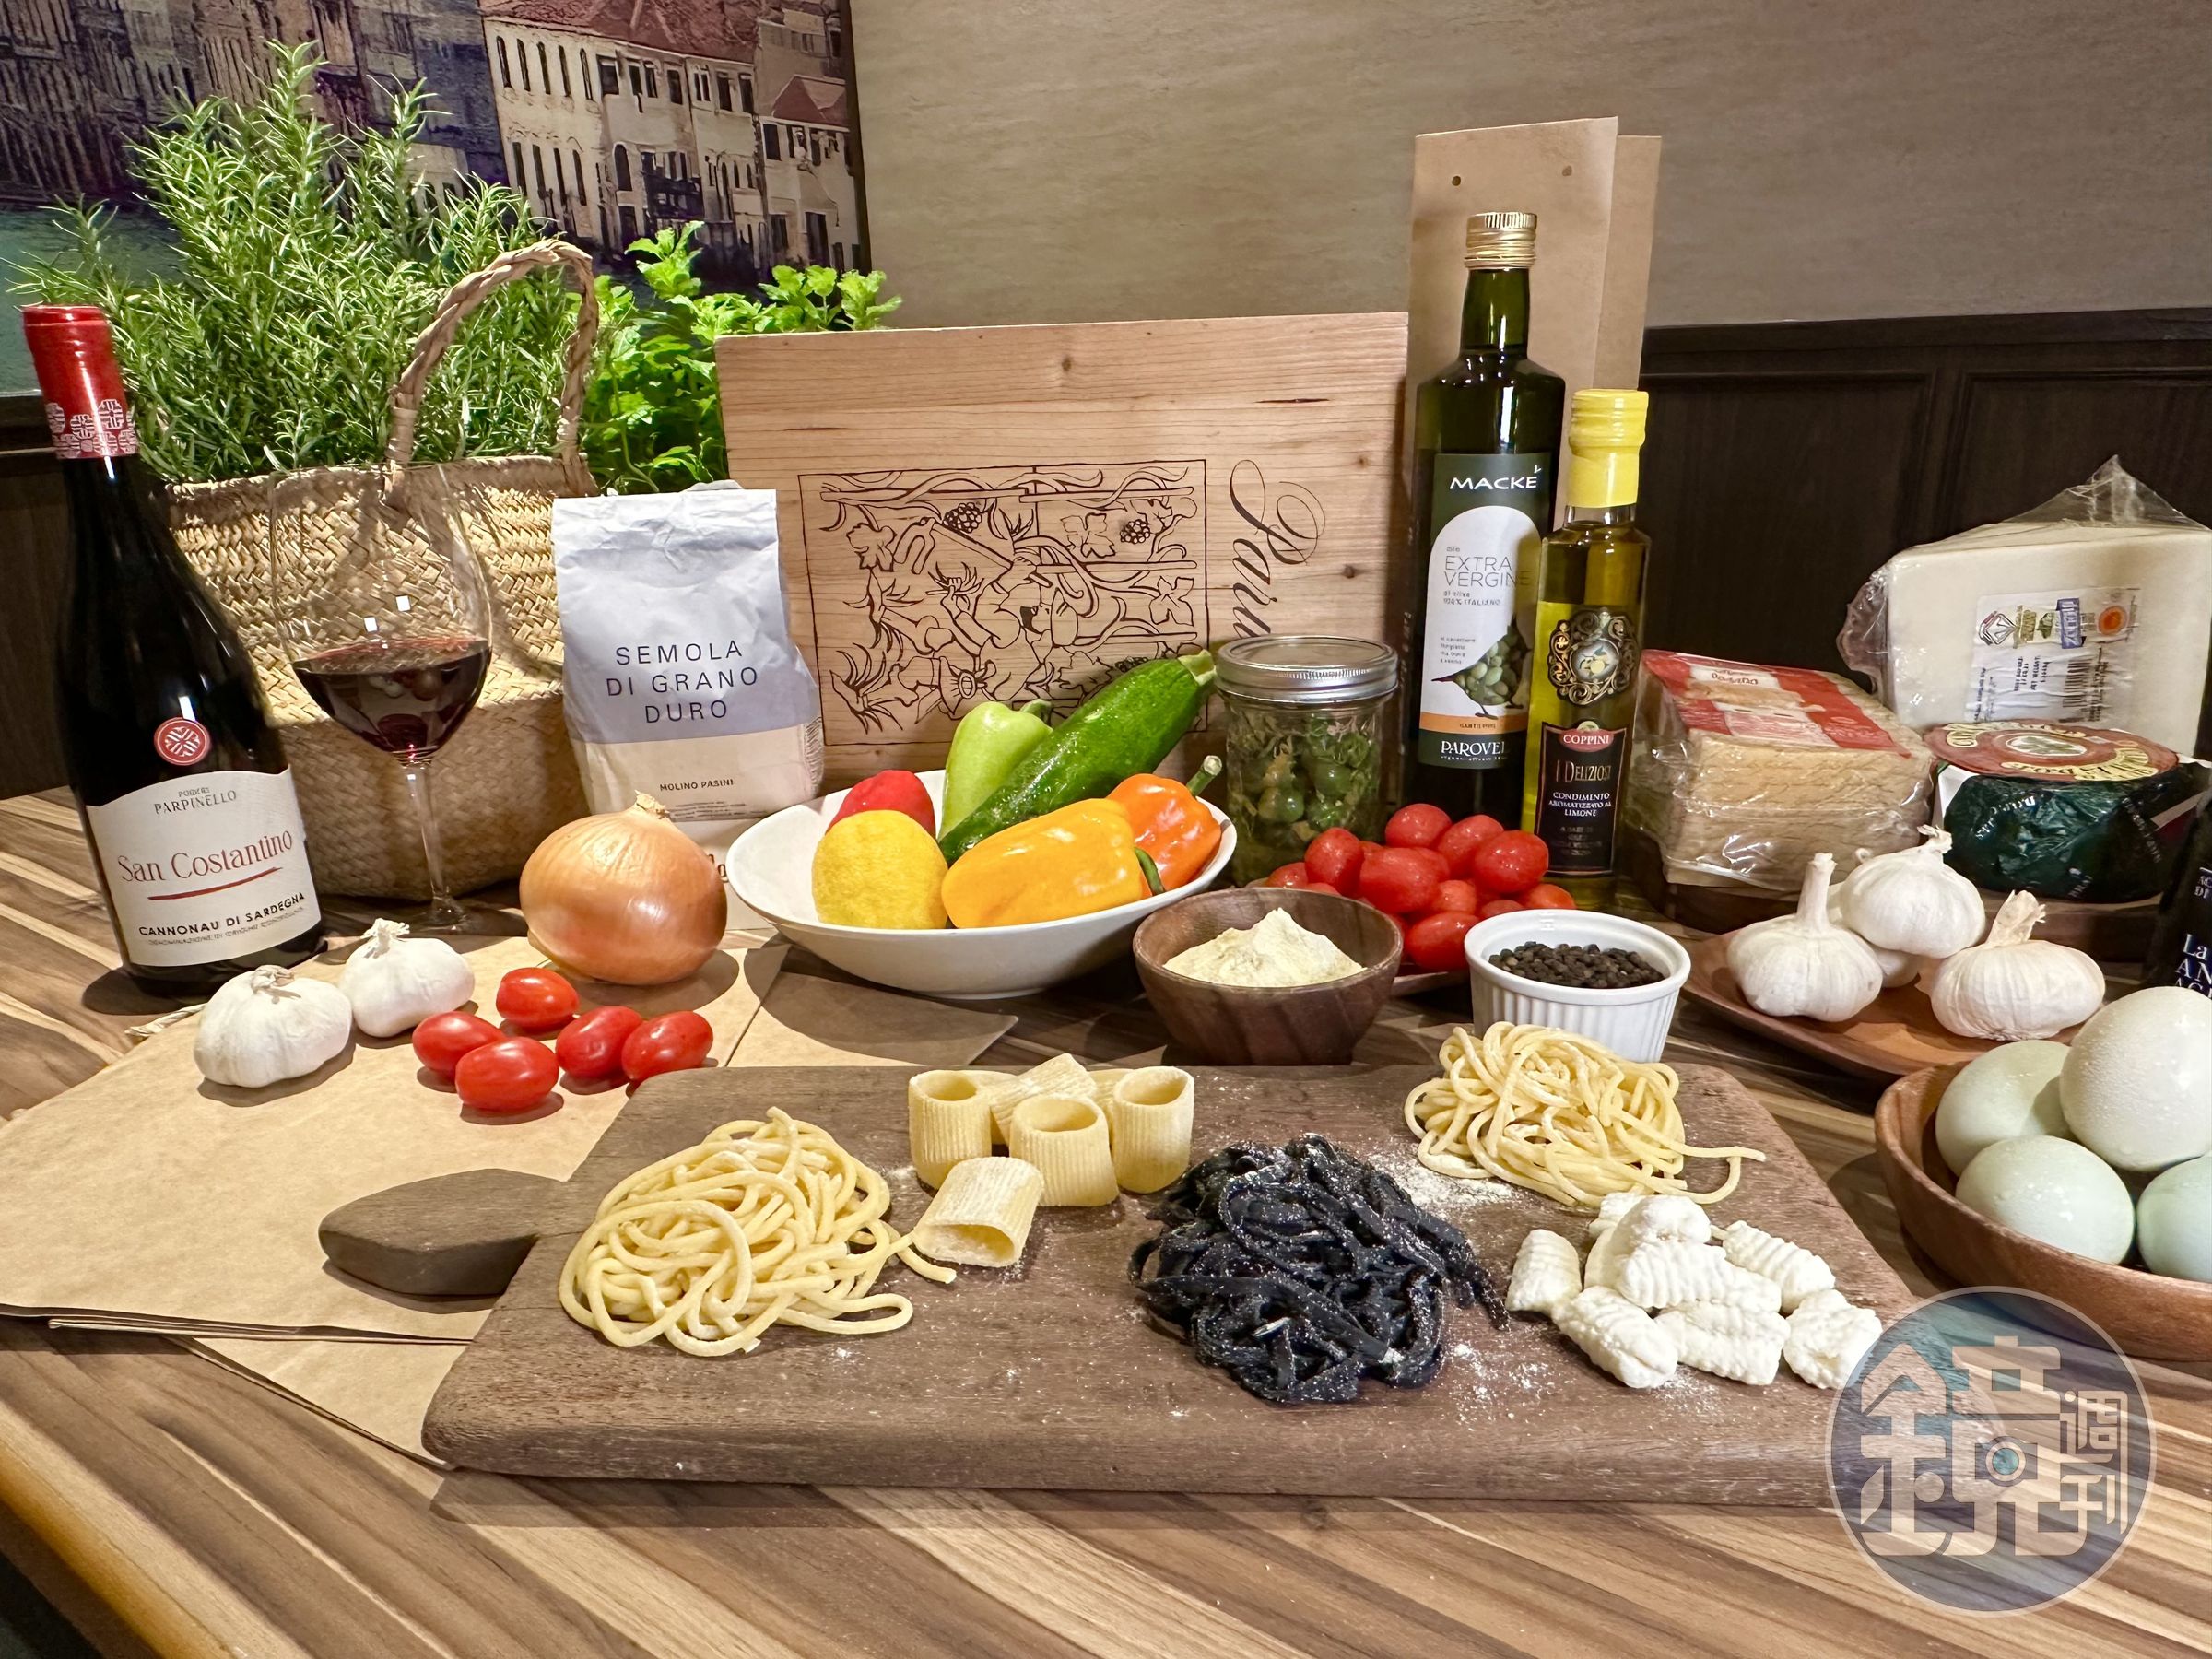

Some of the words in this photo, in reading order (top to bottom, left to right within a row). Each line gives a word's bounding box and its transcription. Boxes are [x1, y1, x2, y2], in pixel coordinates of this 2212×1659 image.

[1445, 555, 1512, 571] EXTRA
[1444, 571, 1531, 587] VERGINE
[616, 640, 742, 665] SEMOLA
[606, 677, 634, 696] DI
[652, 666, 758, 693] GRANO
[645, 700, 727, 724] DURO
[1563, 735, 1610, 745] COPPINI
[659, 782, 699, 792] MOLINO
[700, 778, 735, 789] PASINI
[1553, 792, 1610, 801] CONDIMENTO
[154, 790, 237, 814] PARPINELLO
[1564, 808, 1597, 817] LIMONE
[117, 854, 166, 884] San
[171, 830, 293, 880] Costantino
[138, 921, 219, 936] CANNONAU
[226, 915, 240, 927] DI
[245, 892, 305, 923] SARDEGNA
[2183, 934, 2207, 960] La
